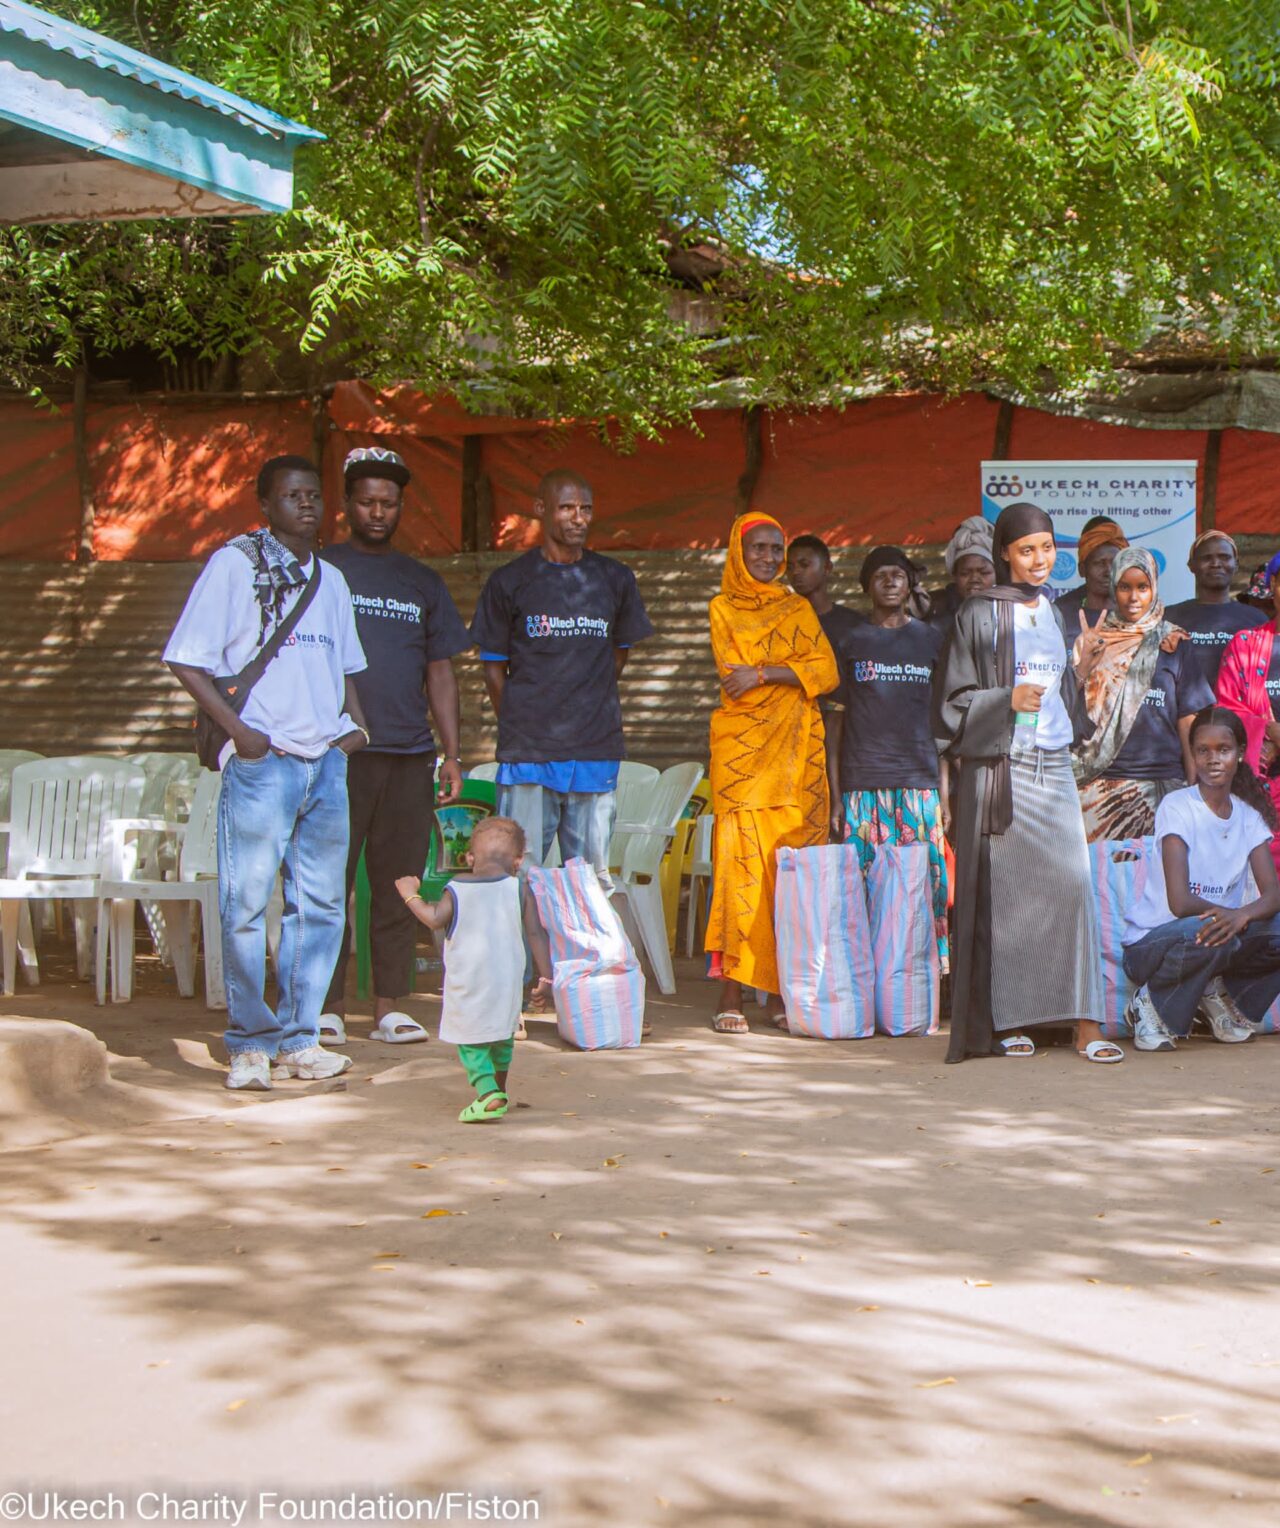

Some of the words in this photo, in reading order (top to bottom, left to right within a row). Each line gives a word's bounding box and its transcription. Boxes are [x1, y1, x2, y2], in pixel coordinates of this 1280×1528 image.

[1025, 480, 1098, 489] UKECH
[1109, 480, 1196, 489] CHARITY
[1033, 490, 1183, 498] FOUNDATION
[1067, 507, 1087, 516] rise
[1091, 507, 1104, 517] by
[1107, 507, 1140, 517] lifting
[1143, 507, 1172, 515] other
[352, 594, 384, 608] Ukech
[386, 598, 421, 616] Charity
[549, 617, 575, 628] Ukech
[577, 616, 609, 632] Charity
[874, 663, 902, 674] Ukech
[904, 664, 932, 679] Charity
[1147, 688, 1166, 701] arity
